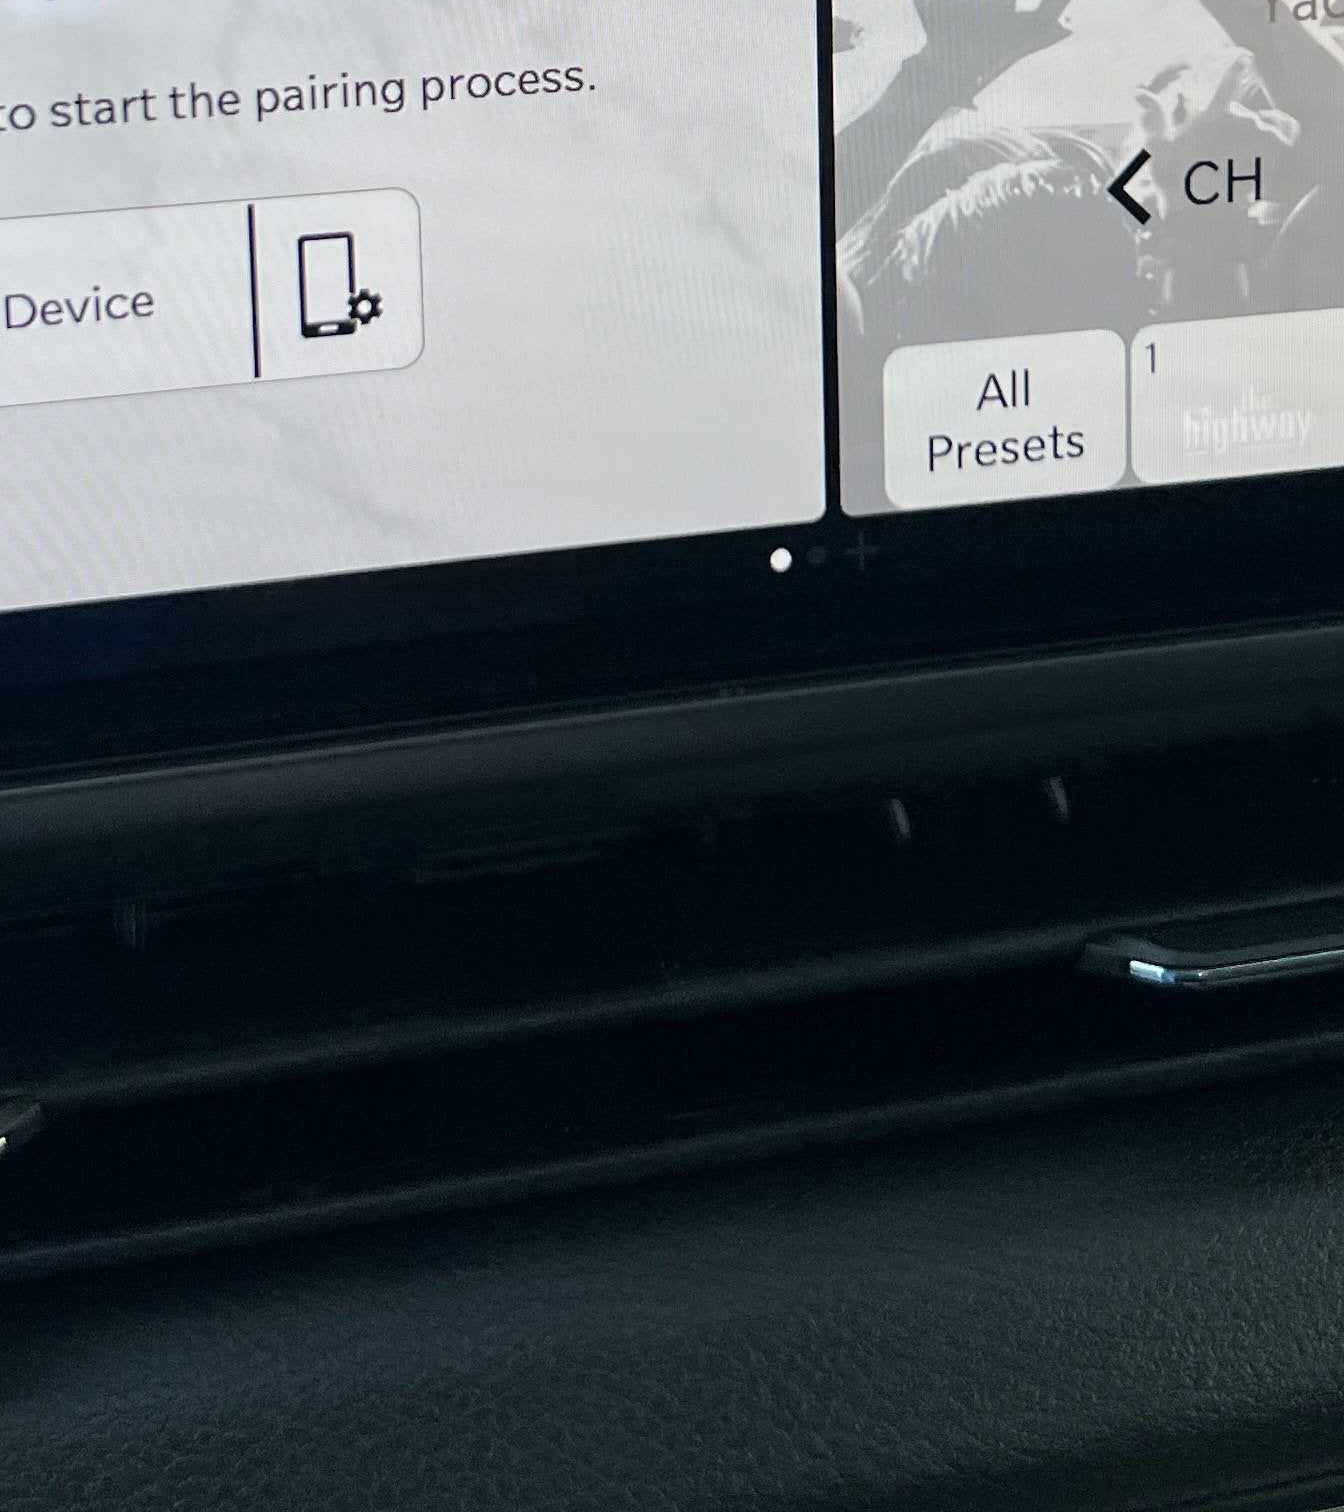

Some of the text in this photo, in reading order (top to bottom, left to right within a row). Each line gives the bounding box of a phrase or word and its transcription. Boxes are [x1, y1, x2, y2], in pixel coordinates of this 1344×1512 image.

[49, 88, 158, 129] start
[167, 81, 242, 120] the
[255, 71, 406, 124] pairing
[421, 65, 597, 112] process.
[1182, 156, 1262, 207] CH
[3, 284, 155, 331] Device
[1144, 341, 1157, 375] 1
[975, 368, 1031, 412] All
[927, 424, 1085, 474] Presets
